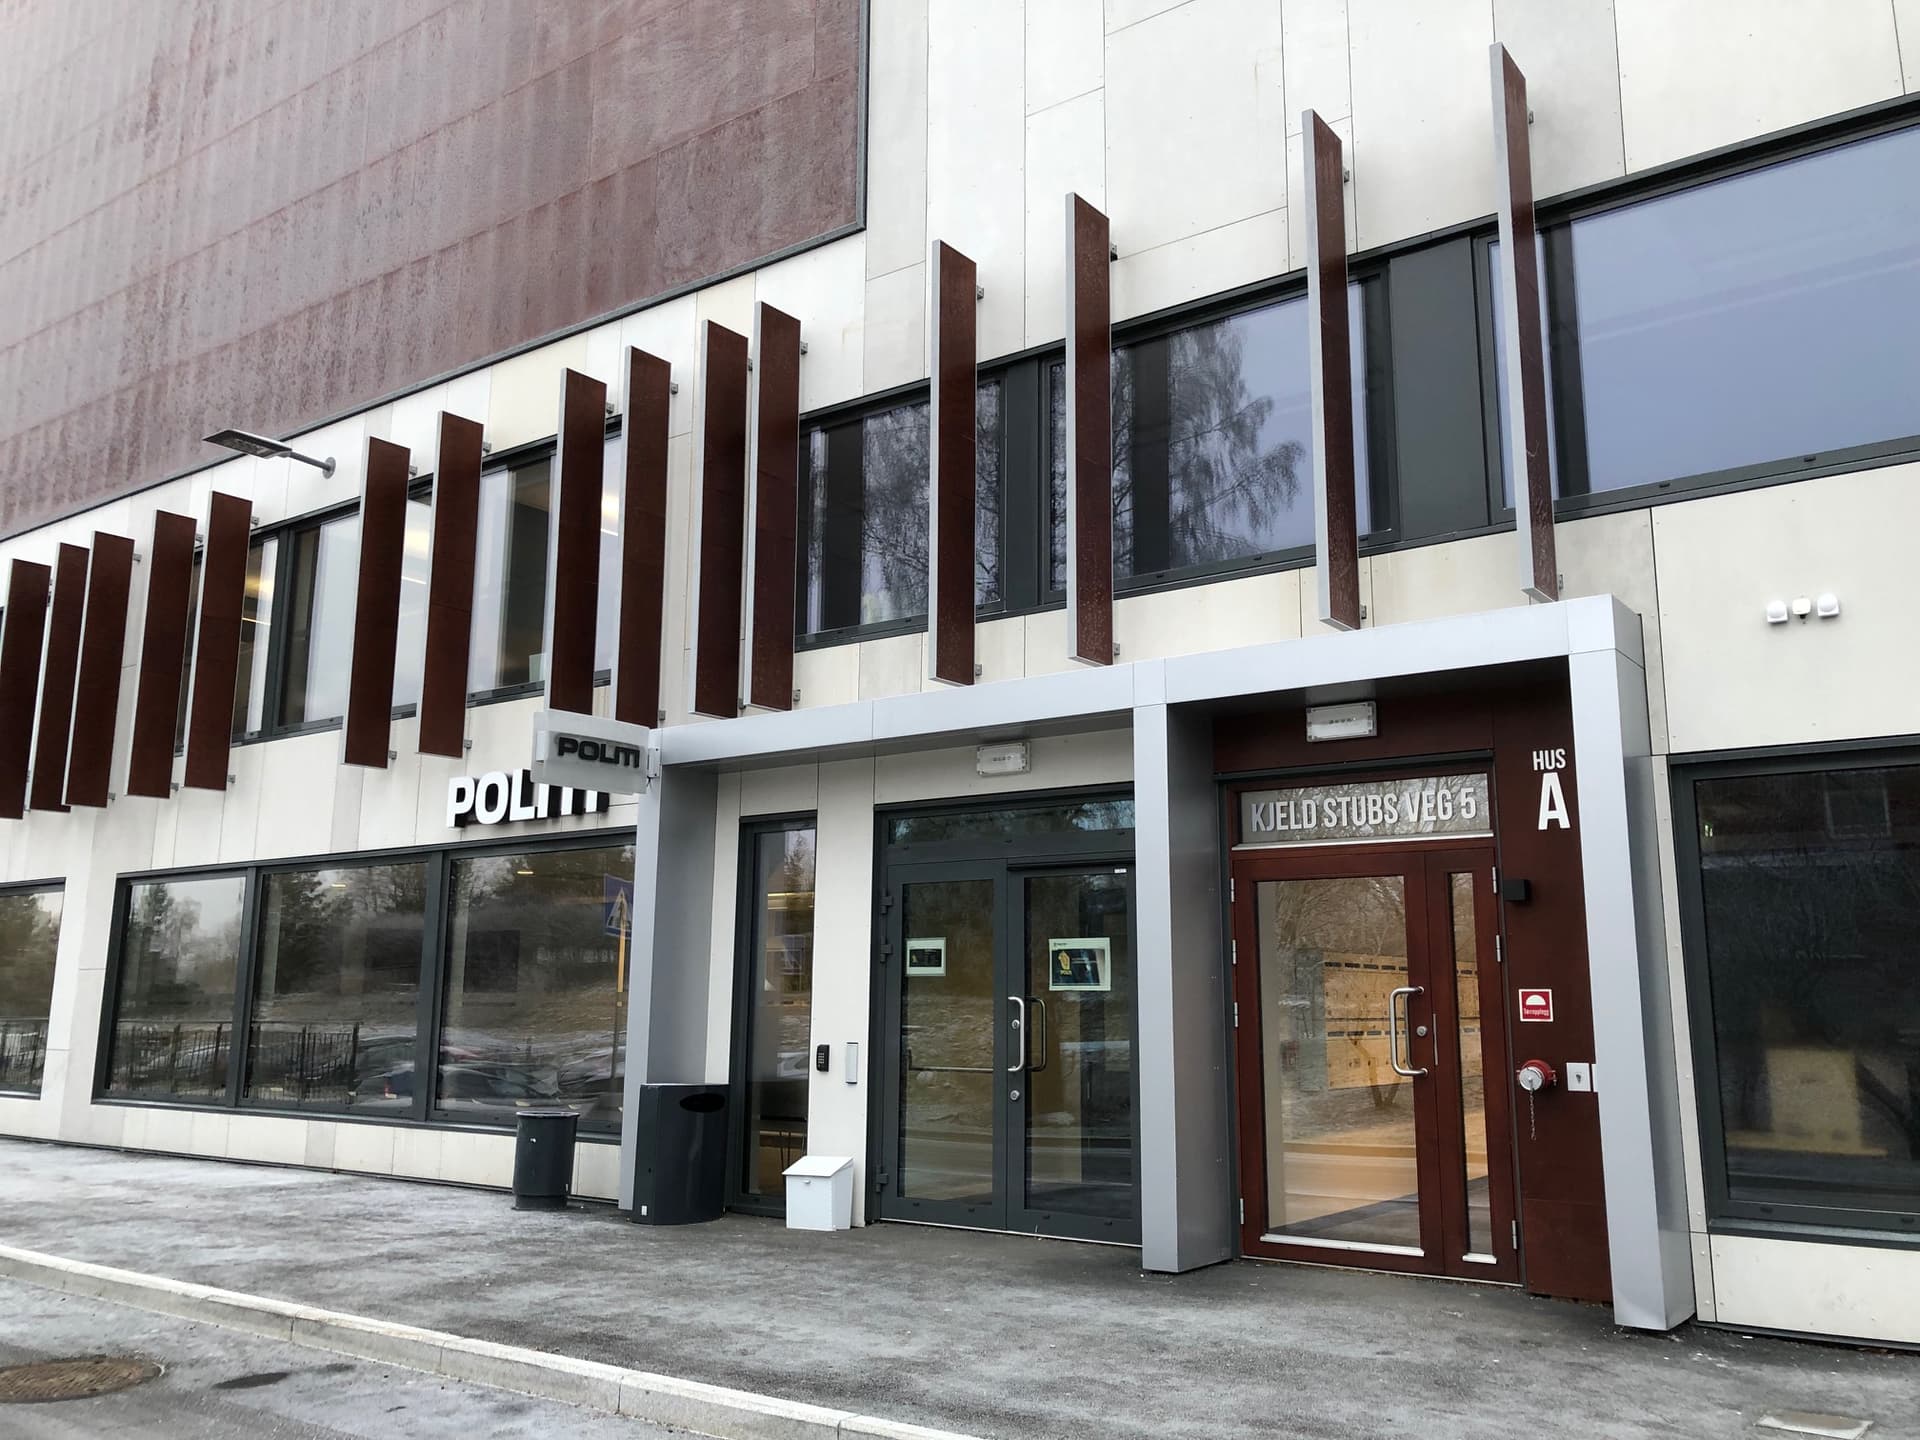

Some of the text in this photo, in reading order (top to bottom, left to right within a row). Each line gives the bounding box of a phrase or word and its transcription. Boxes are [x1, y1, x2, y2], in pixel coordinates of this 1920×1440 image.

[557, 736, 641, 769] POLITI
[1532, 748, 1566, 771] HUS
[1251, 787, 1477, 833] KJELD STUBS VEG 5
[1537, 772, 1571, 831] A
